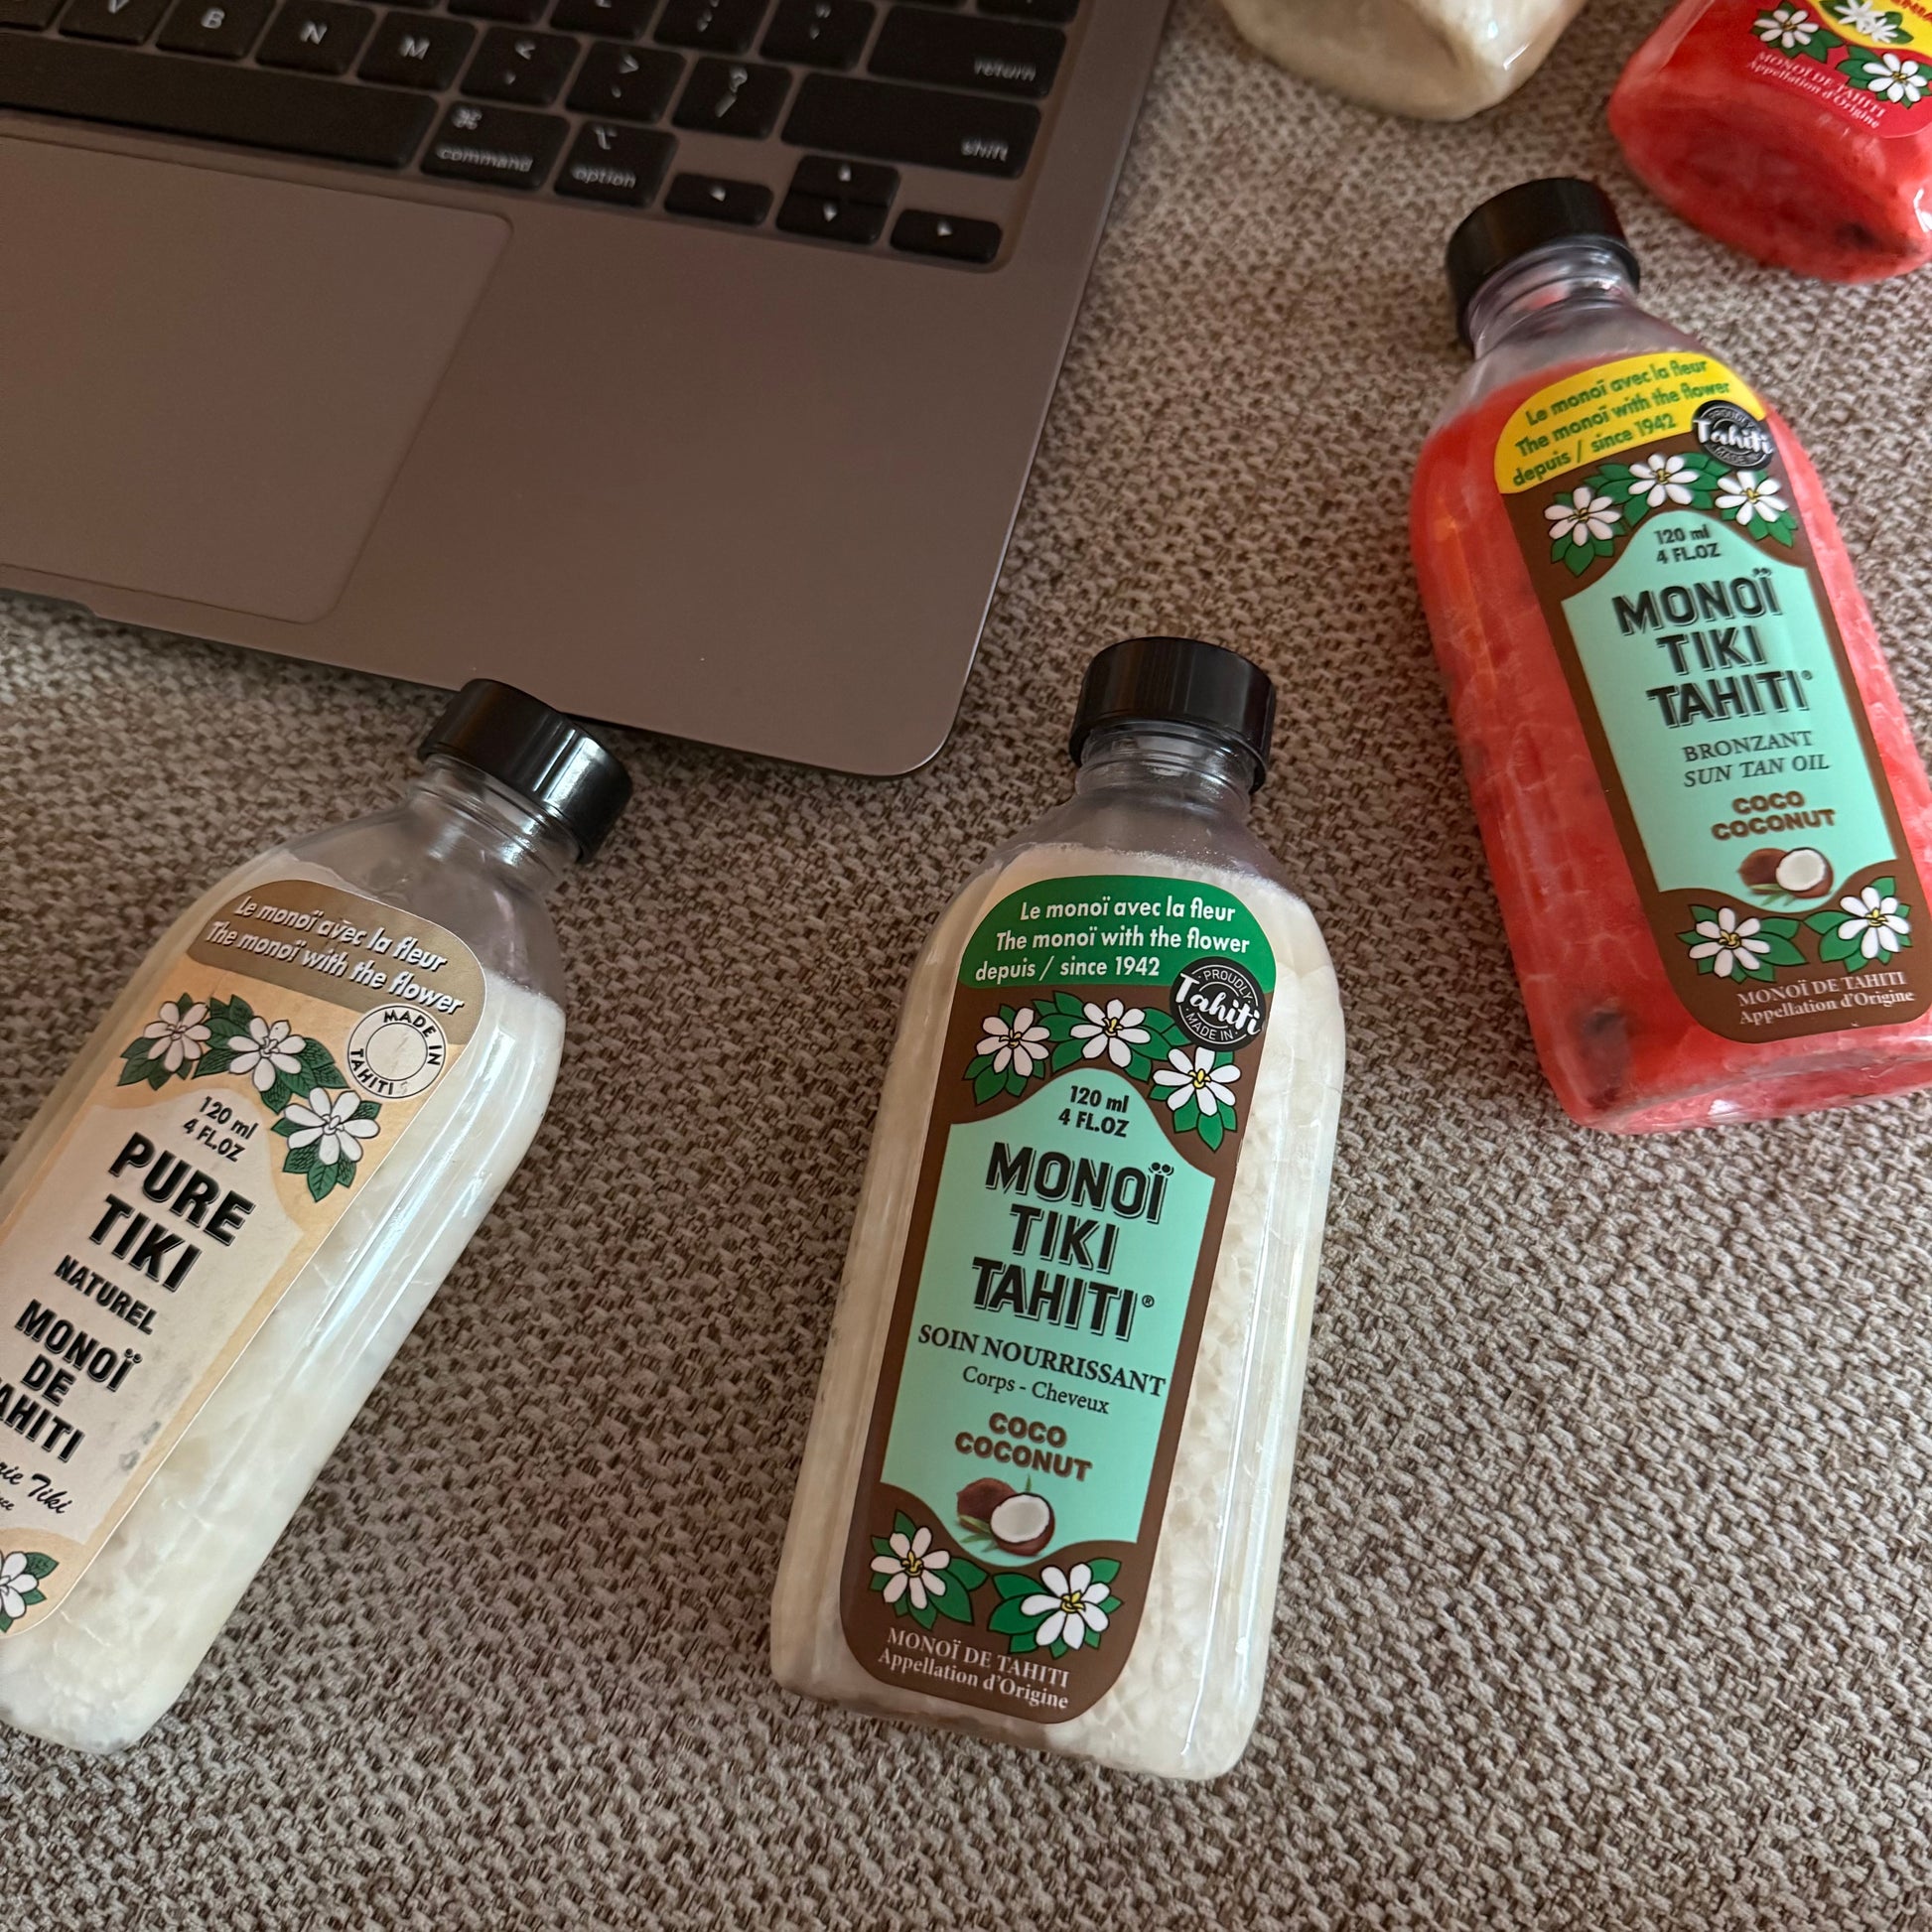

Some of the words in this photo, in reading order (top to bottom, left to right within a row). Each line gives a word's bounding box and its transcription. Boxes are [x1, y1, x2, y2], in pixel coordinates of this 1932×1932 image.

[201, 8, 226, 31] B
[300, 21, 328, 46] N
[401, 34, 430, 61] M
[973, 57, 1036, 82] return
[1747, 61, 1821, 94] Appellation
[435, 144, 535, 173] command
[960, 137, 1009, 163] shift
[570, 164, 636, 190] option
[1525, 408, 1549, 427] Le
[1551, 381, 1608, 415] monoï
[1610, 370, 1650, 393] avec
[1652, 363, 1672, 381] la
[1671, 358, 1708, 378] fleur
[1514, 435, 1549, 458] The
[1553, 405, 1609, 443] monoï
[1611, 395, 1650, 420] with
[1652, 388, 1679, 408] the
[1680, 381, 1730, 402] flower
[1693, 419, 1774, 454] Tahiti
[1512, 441, 1572, 487] depuis
[1590, 427, 1633, 454] since
[1636, 413, 1676, 437] 1942
[1654, 526, 1685, 545] 120
[1690, 523, 1710, 540] ml
[1656, 549, 1668, 564] 4
[1672, 543, 1722, 562] FL.OZ
[1611, 567, 1783, 636] MONOÏ
[1656, 624, 1767, 676] TIKI
[1682, 730, 1813, 762] BRONZANT
[1683, 764, 1732, 787] SUN
[1739, 758, 1785, 777] TAN
[1791, 754, 1830, 772] OIL
[1731, 790, 1805, 815] COCO
[1711, 809, 1836, 840] COCONUT
[1020, 901, 1040, 921] Le
[1045, 897, 1112, 919] monoï
[1114, 900, 1161, 917] avec
[1166, 896, 1184, 918] la
[1190, 897, 1236, 921] fleur
[233, 897, 254, 916] Le
[256, 908, 324, 931] monoï
[318, 919, 367, 946] avec
[366, 927, 393, 954] la
[392, 937, 448, 972] fleur
[996, 932, 1027, 951] The
[1033, 926, 1097, 948] monoï
[1101, 926, 1144, 947] with
[1150, 929, 1181, 948] the
[1186, 927, 1250, 954] flower
[204, 921, 236, 945] The
[237, 939, 305, 963] monoï
[300, 947, 349, 978] with
[348, 960, 387, 990] the
[388, 971, 465, 1016] flower
[975, 959, 1035, 985] depuis
[1059, 958, 1108, 976] since
[1115, 956, 1161, 977] 1942
[1202, 969, 1253, 999] PROUDLY
[1175, 973, 1261, 1035] Tahiti
[1736, 979, 1808, 1007] MONOÏ
[1811, 978, 1839, 996] DE
[1841, 971, 1907, 991] TAHITI
[383, 1010, 437, 1037] MADE
[1185, 1012, 1217, 1039] MADE
[1220, 1029, 1234, 1040] IN
[1739, 999, 1838, 1026] Appellation
[350, 1048, 394, 1095] TAHITI
[427, 1045, 443, 1065] IN
[1069, 1085, 1102, 1106] 120
[1106, 1094, 1129, 1114] ml
[199, 1095, 232, 1125] 120
[230, 1122, 259, 1141] ml
[1058, 1108, 1070, 1125] 4
[1076, 1113, 1130, 1138] FL.OZ
[183, 1118, 195, 1135] 4
[197, 1128, 246, 1163] FL.OZ
[107, 1131, 257, 1247] PURE
[985, 1142, 1174, 1224] MONOÏ
[88, 1193, 203, 1293] TIKI
[1010, 1203, 1120, 1275] TIKI
[54, 1254, 159, 1335] NATUREL
[14, 1299, 143, 1392] MONOÏ
[918, 1323, 979, 1353] SOIN
[981, 1336, 1167, 1397] NOURRISSANT
[20, 1353, 77, 1407] DE
[962, 1365, 1015, 1395] Corps
[1032, 1381, 1110, 1414] Cheveux
[0, 1376, 86, 1463] AHITI
[989, 1412, 1067, 1448] COCO
[954, 1431, 1093, 1482] COCONUT
[27, 1472, 72, 1514] Tiki
[878, 1647, 979, 1688] Appellation
[887, 1627, 963, 1661] MONOÏ
[963, 1647, 993, 1668] DE
[997, 1654, 1071, 1689] TAHITI
